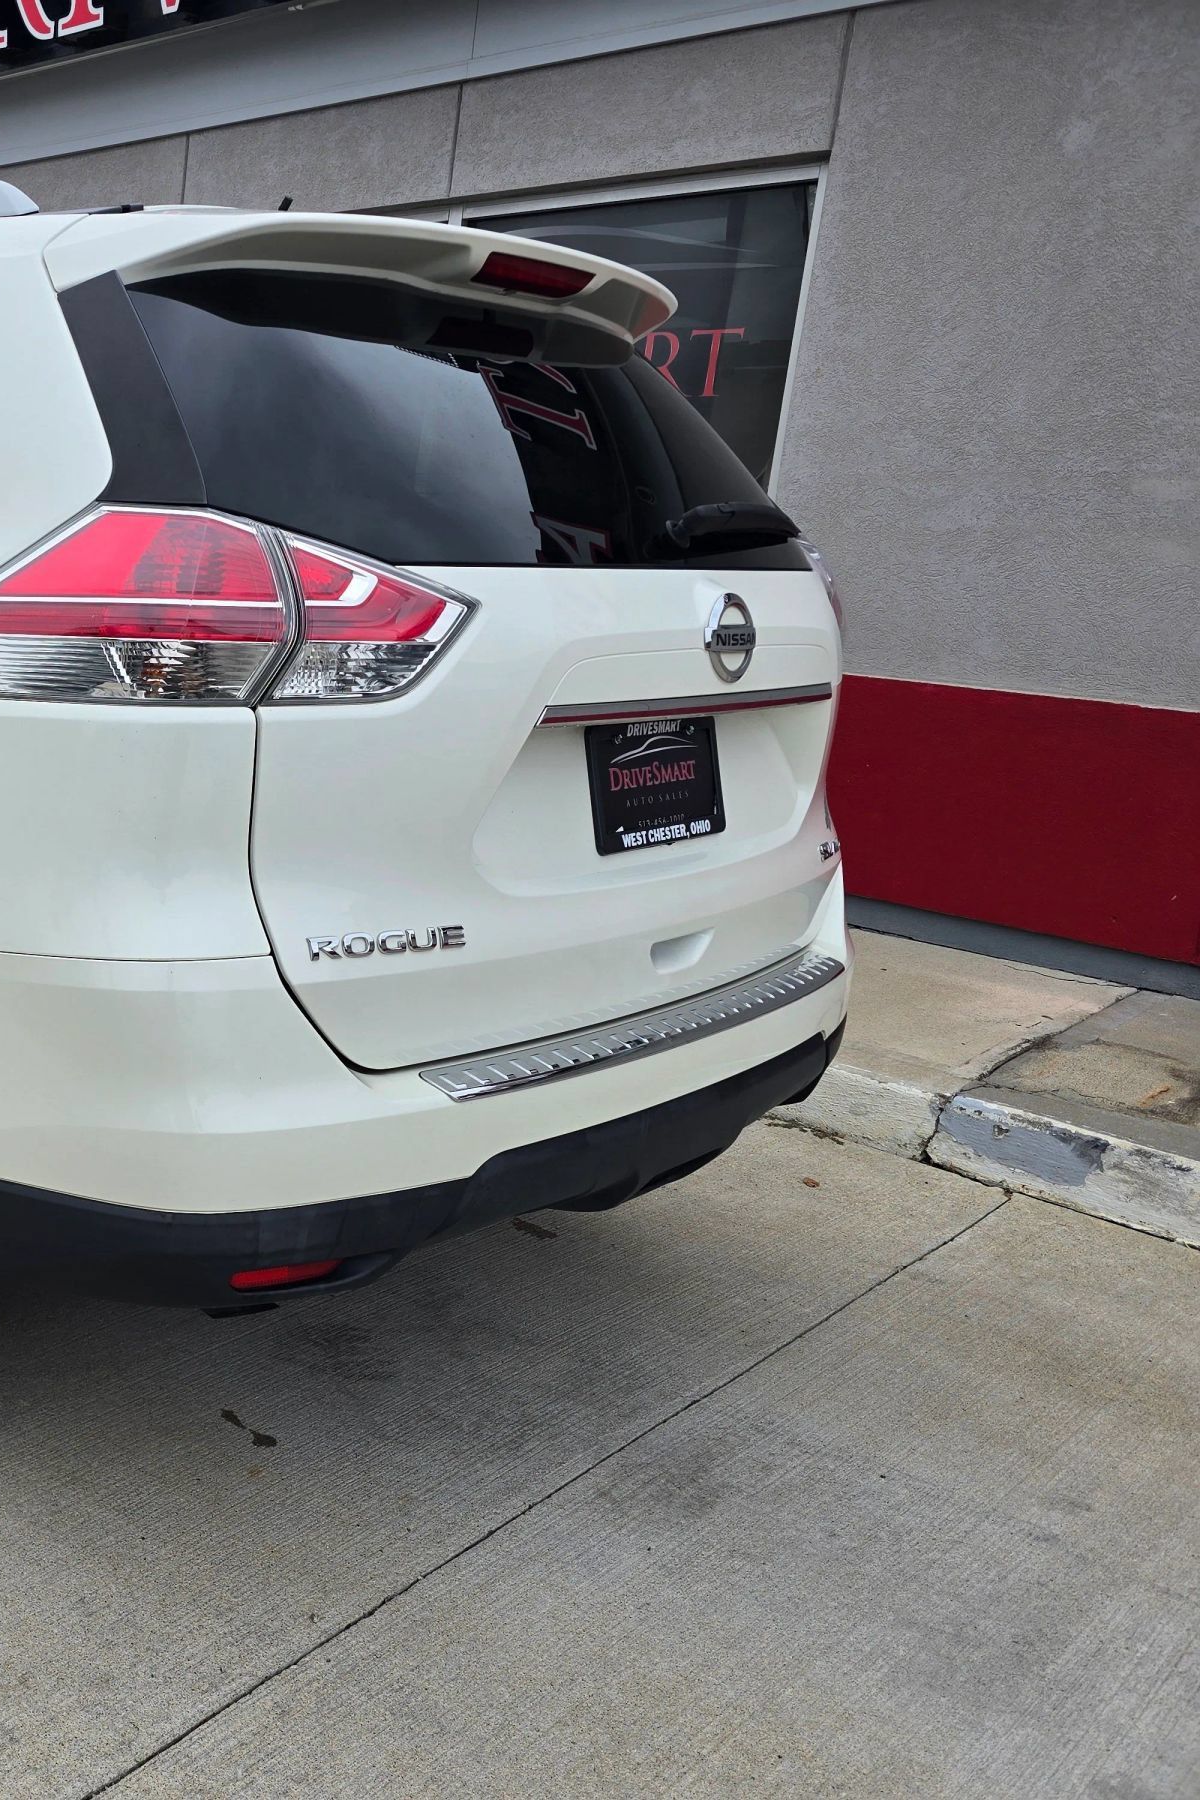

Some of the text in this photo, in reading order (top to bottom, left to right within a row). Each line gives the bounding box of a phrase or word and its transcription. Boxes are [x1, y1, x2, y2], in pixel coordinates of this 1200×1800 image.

[627, 720, 681, 737] DRIVESMART
[626, 792, 689, 807] AUTO SALES
[622, 819, 711, 848] WEST CHESTER, OHIO
[306, 925, 467, 962] ROGUE
